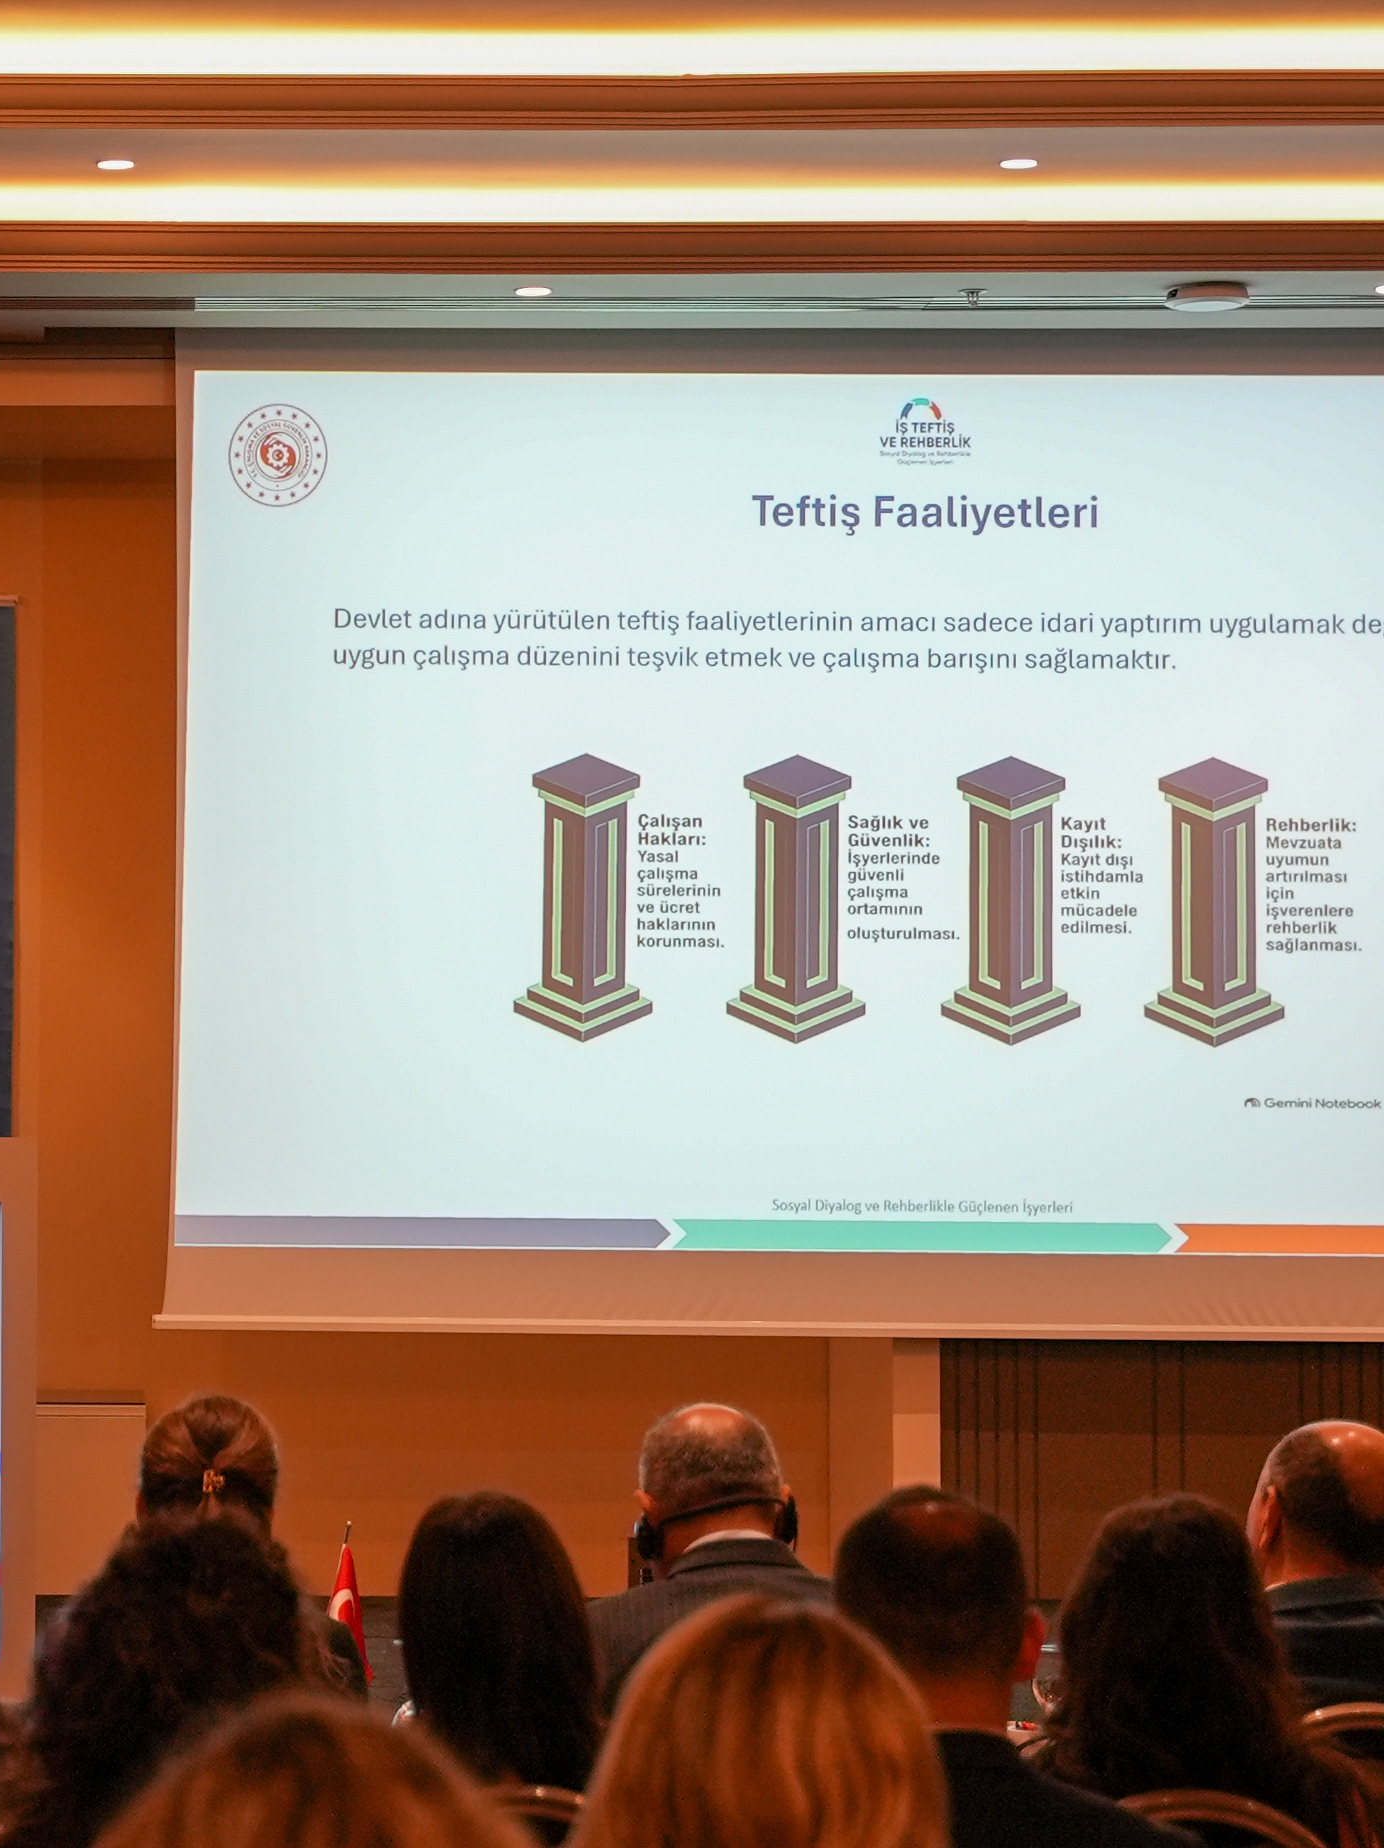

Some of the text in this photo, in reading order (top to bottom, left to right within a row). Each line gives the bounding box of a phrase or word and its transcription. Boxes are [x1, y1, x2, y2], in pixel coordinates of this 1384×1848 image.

[895, 419, 955, 436] İŞ TEFTİŞ
[879, 433, 971, 449] VE REHBERLİK
[751, 493, 1098, 537] Teftiş Faaliyetleri
[334, 607, 1384, 639] Devlet adına yürütülen teftiş faaliyetlerinin amacı sadece idari yaptırım uygulamak de
[333, 644, 1176, 674] uygun çalışma düzenini teşvik etmek ve çalışma barışını sağlamaktır.
[637, 813, 703, 832] Çalışan
[847, 814, 929, 833] Sağlık ve
[1061, 816, 1106, 834] Kayıt
[1266, 817, 1357, 833] Rehberlik:
[638, 831, 706, 846] Hakları:
[847, 830, 930, 848] Güvenlik:
[1061, 834, 1122, 852] Dışılık:
[1266, 835, 1342, 850] Mevzuata
[637, 849, 679, 863] Yasal
[847, 848, 941, 868] İşyerlerinde
[1061, 852, 1133, 870] Kayıt dışı
[1265, 855, 1330, 869] uyumun
[636, 867, 698, 883] çalışma
[847, 867, 904, 884] güvenli
[1060, 869, 1144, 884] istihdamla
[1265, 870, 1348, 884] artırılması
[636, 881, 721, 897] sürelerinin
[847, 885, 908, 901] çalışma
[1060, 886, 1100, 900] etkin
[1266, 886, 1295, 903] için
[636, 900, 701, 914] ve ücret
[847, 899, 923, 916] ortamının
[1060, 903, 1138, 918] mücadele
[1266, 903, 1354, 920] işverenlere
[636, 917, 716, 931] haklarının
[1060, 920, 1132, 935] edilmesi.
[1266, 920, 1338, 935] rehberlik
[636, 934, 725, 949] korunması.
[847, 926, 960, 943] oluşturulması.
[1265, 937, 1363, 954] sağlanması.
[1264, 1097, 1382, 1109] Gemini Notebook
[772, 1198, 1073, 1217] Sosyal Diyalog ve Rehberlikle Güçlenen İşyerleri
